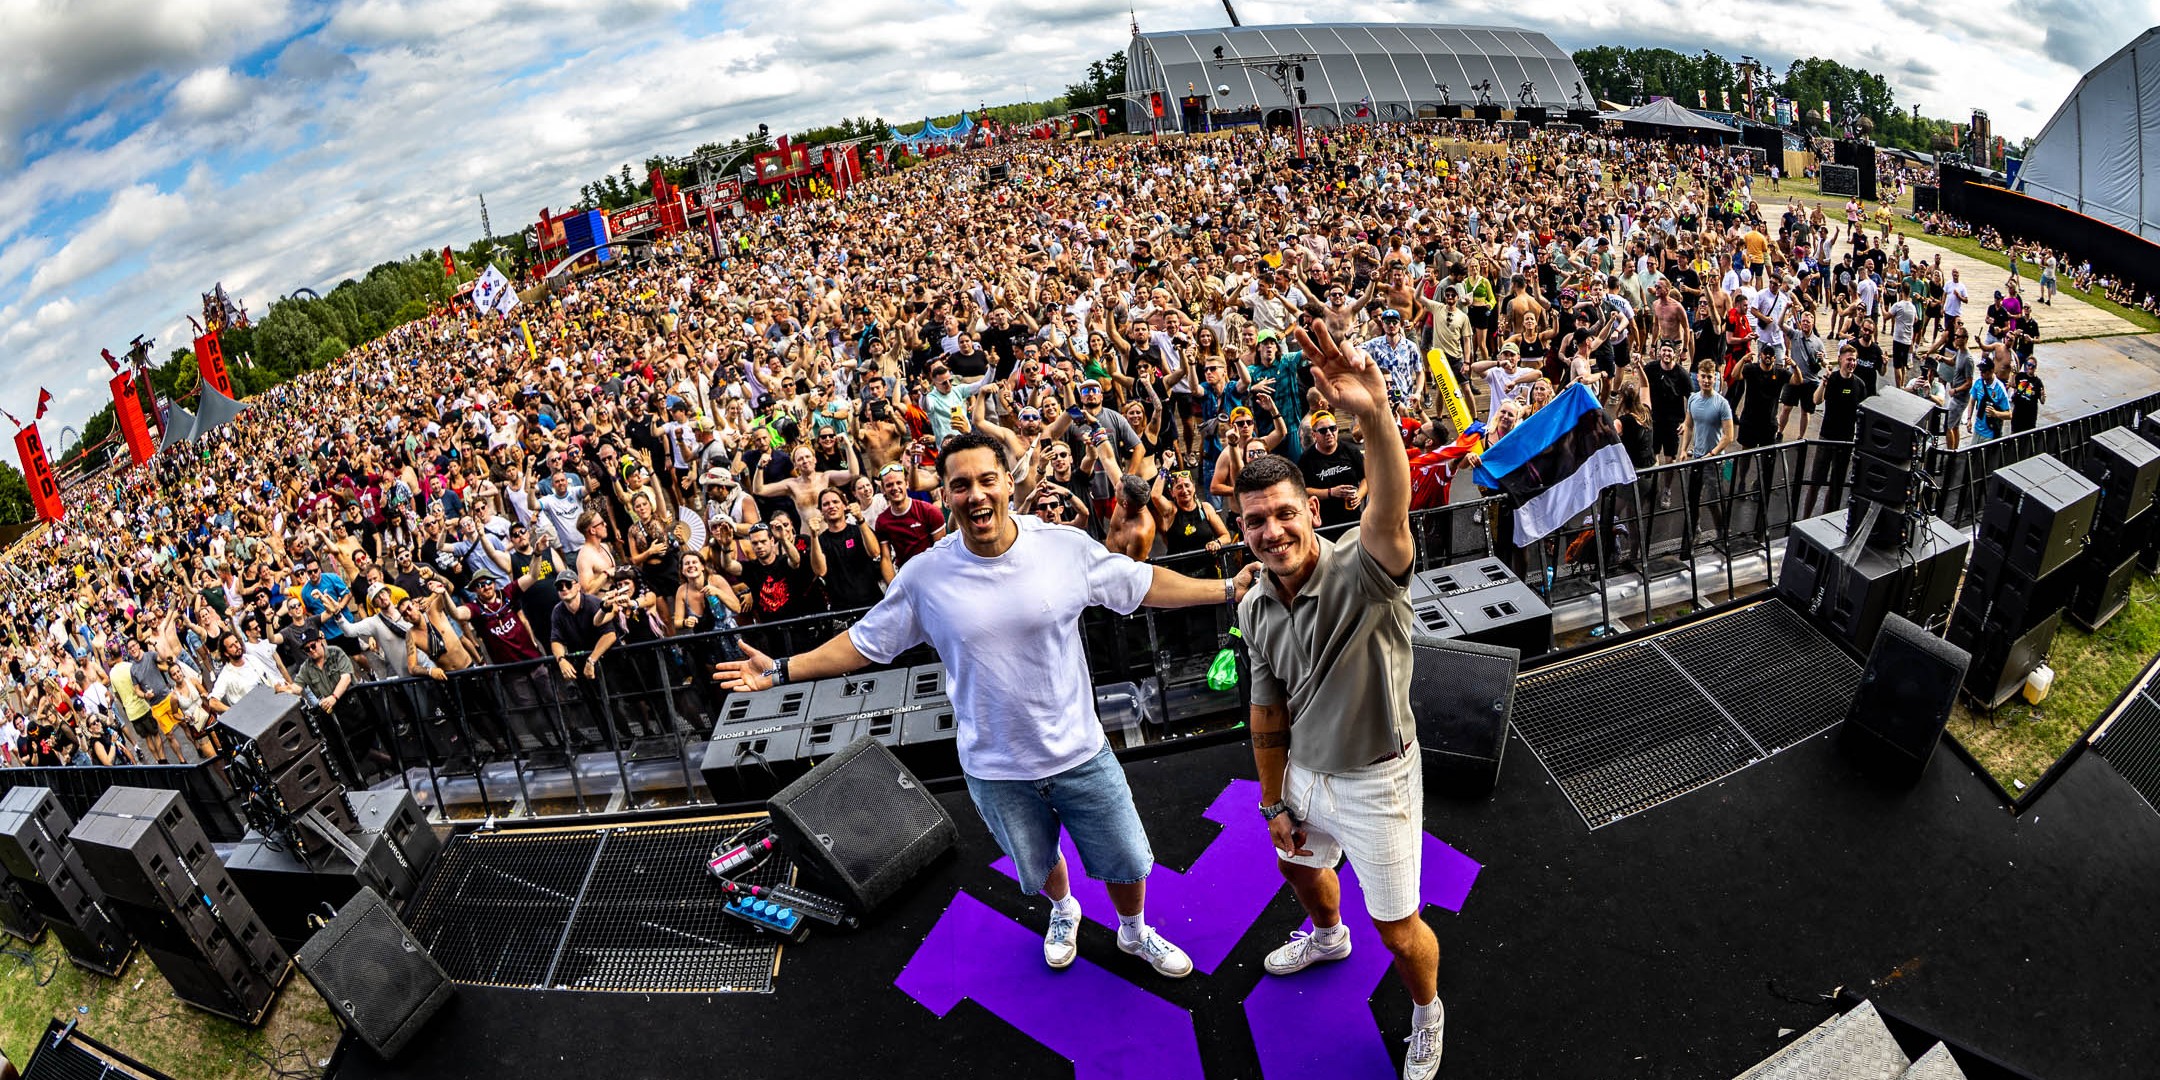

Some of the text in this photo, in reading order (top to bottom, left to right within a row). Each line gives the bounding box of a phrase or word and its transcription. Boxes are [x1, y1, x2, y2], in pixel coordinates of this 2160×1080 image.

[207, 339, 229, 392] RED
[1436, 373, 1458, 418] DOMINATOR
[26, 434, 54, 499] RED
[1448, 578, 1509, 596] PURPLE GROUP
[846, 704, 922, 721] PURPLE GROUP
[713, 725, 782, 741] PURPLE GROUP
[388, 840, 408, 868] GROUP
